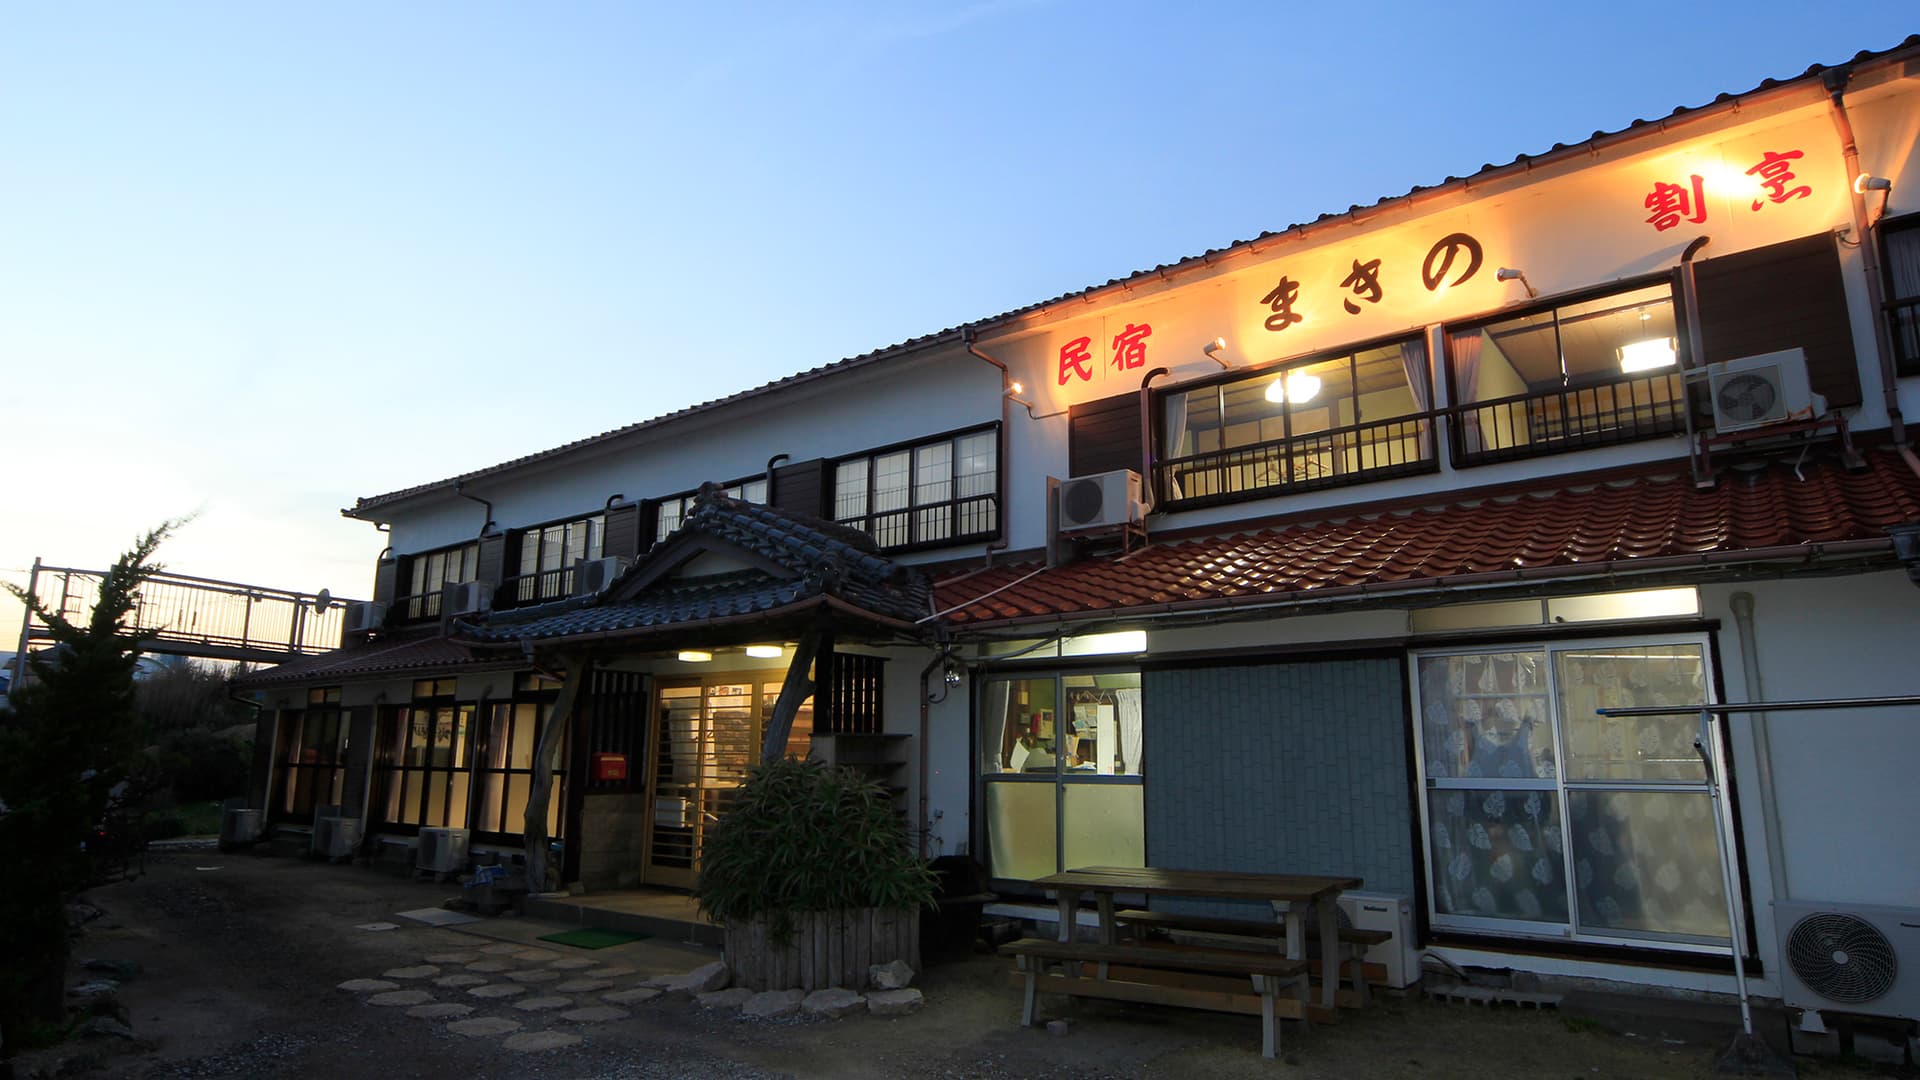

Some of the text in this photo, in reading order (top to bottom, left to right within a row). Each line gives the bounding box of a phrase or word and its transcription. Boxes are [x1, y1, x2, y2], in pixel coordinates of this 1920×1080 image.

[1058, 149, 1813, 386] 民宿 まきの 割烹
